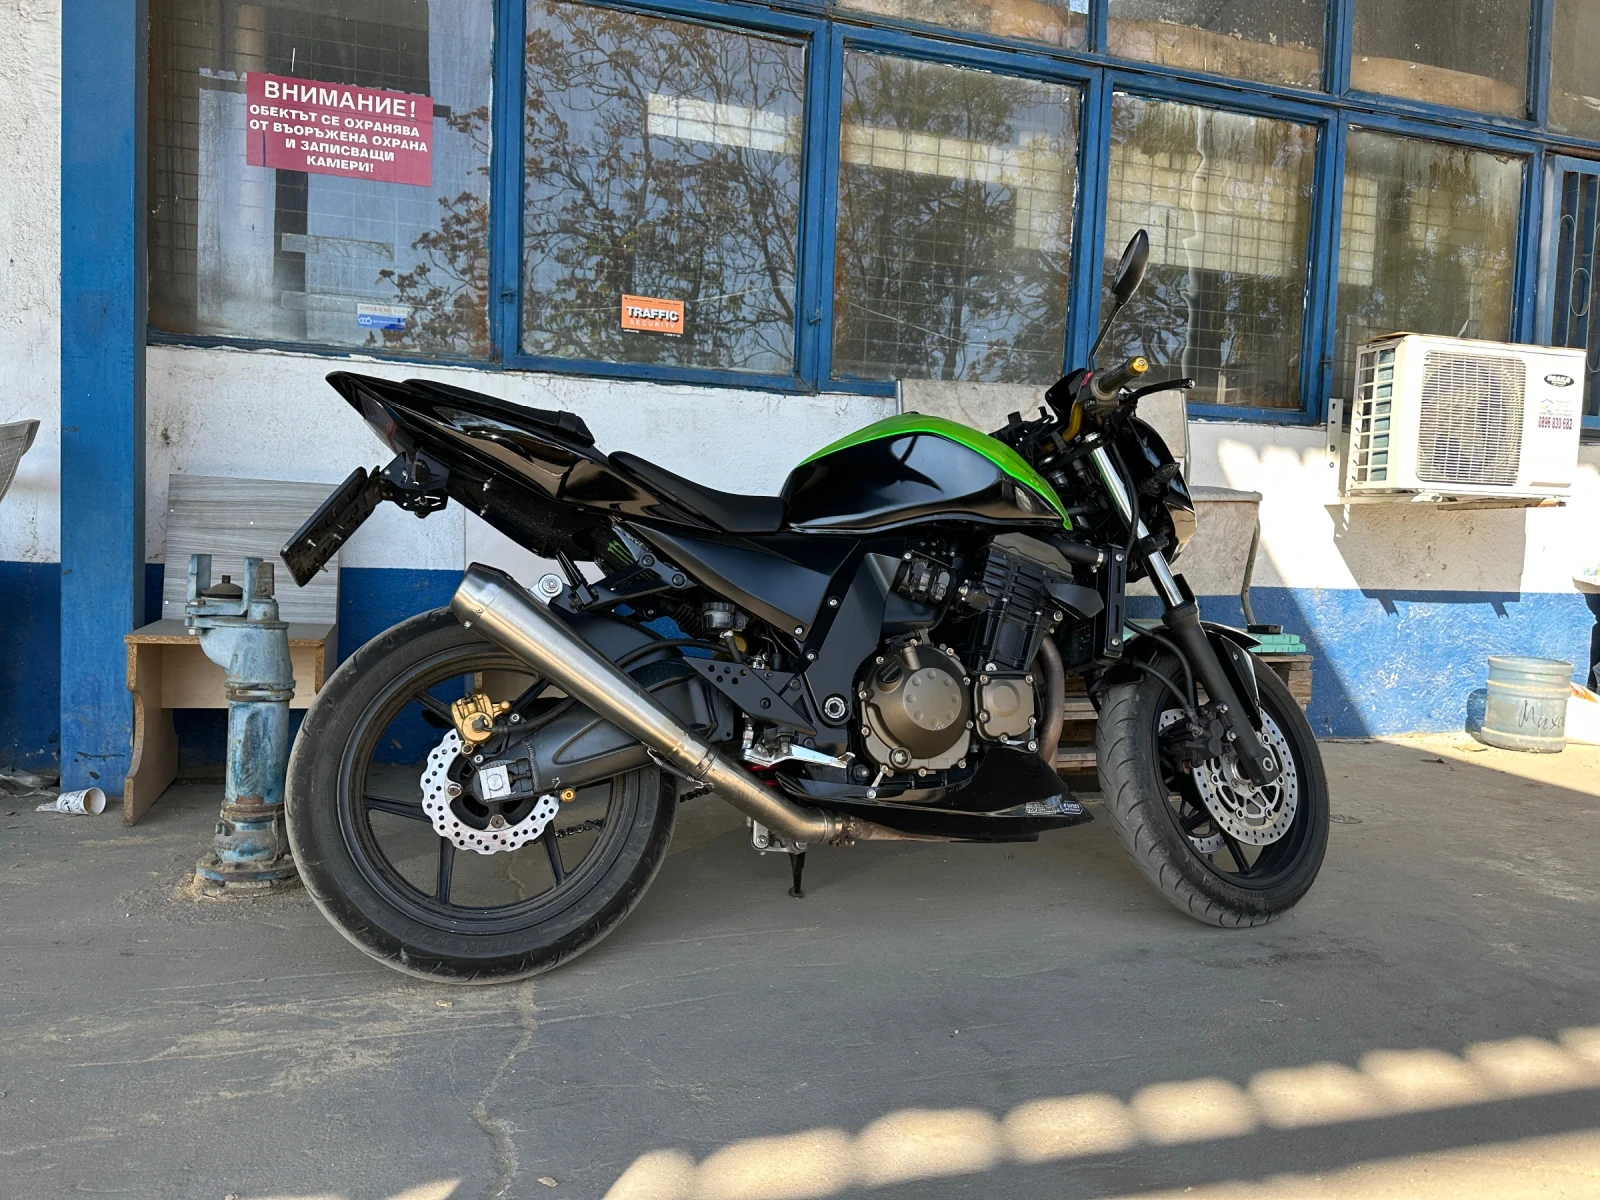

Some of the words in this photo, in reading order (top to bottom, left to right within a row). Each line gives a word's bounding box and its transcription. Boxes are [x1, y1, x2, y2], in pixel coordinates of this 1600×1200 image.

[264, 80, 416, 118] ВНИМАНИЕ!
[249, 104, 318, 122] ОБЕКТЪТ
[321, 114, 340, 127] СЕ
[344, 117, 420, 137] ОХРАНЯВА
[249, 119, 269, 130] ОТ
[273, 122, 368, 144] ВЪОРЪЖЕНА
[371, 135, 428, 152] ОХРАНА
[285, 138, 296, 149] И
[300, 140, 395, 162] ЗАПИСВАЩИ
[306, 155, 374, 173] КАМЕРИ!
[625, 305, 679, 322] TRAFFIC
[629, 318, 675, 329] SECURITY
